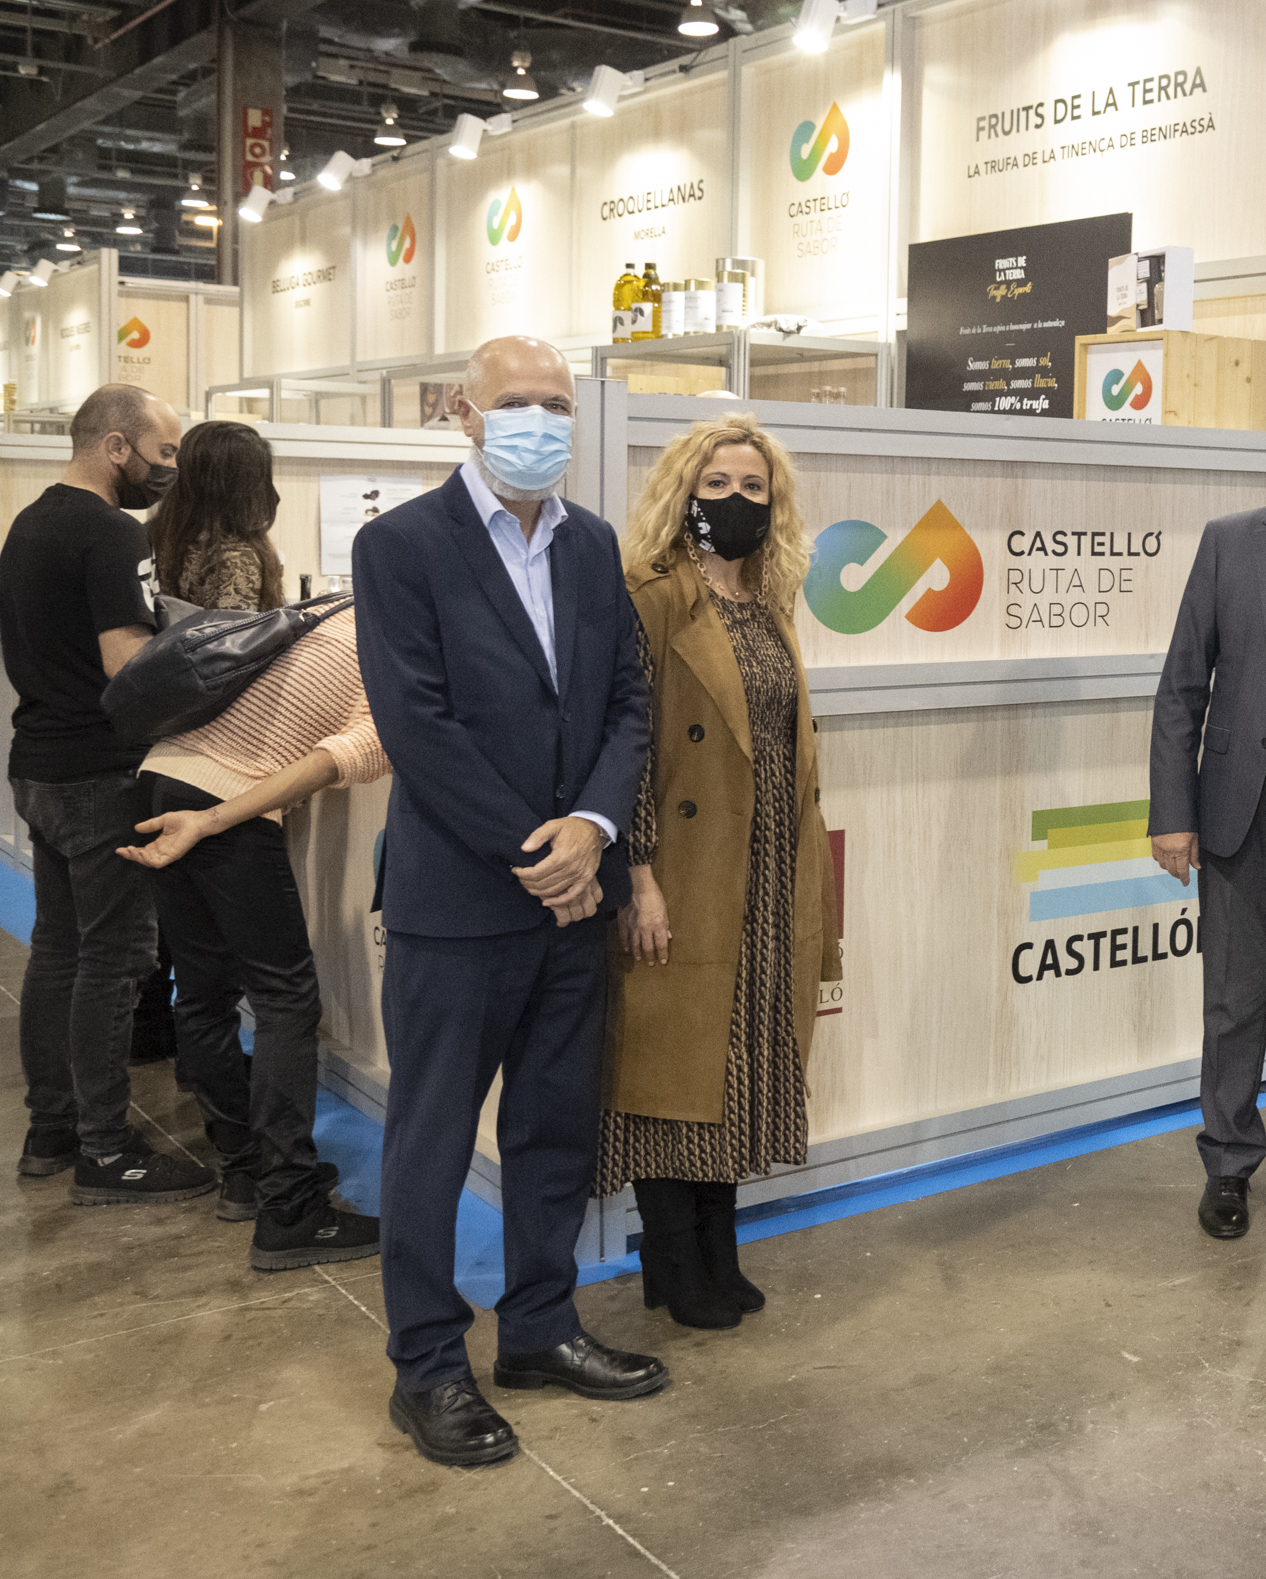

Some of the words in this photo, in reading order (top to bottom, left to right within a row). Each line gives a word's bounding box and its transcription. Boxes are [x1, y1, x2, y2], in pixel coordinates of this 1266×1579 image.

[975, 102, 1045, 142] FRUITS
[1053, 93, 1082, 125] DE
[1091, 86, 1119, 117] LA
[1127, 66, 1208, 108] TERRA
[967, 163, 981, 179] LA
[984, 156, 1019, 175] TRUFA
[1022, 151, 1038, 168] DE
[1042, 148, 1056, 164] LA
[1060, 137, 1115, 160] TINENÇA
[1119, 131, 1137, 149] DE
[1141, 112, 1216, 145] BENIFASSÀ
[600, 179, 705, 222] CROQUELLANAS
[633, 226, 666, 241] MORELLA
[793, 219, 823, 239] RUTA
[827, 215, 843, 233] DE
[797, 236, 838, 259] SABOR
[995, 257, 1017, 270] FRUITS
[1017, 255, 1027, 267] DE
[302, 265, 337, 288] GOURMET
[996, 271, 1005, 281] LA
[1005, 268, 1026, 280] TERRA
[966, 356, 990, 371] Somos
[990, 355, 1013, 371] tierra,
[1014, 357, 1038, 368] somos
[1038, 351, 1052, 369] sol,
[962, 380, 984, 391] somos
[984, 376, 1008, 392] viento,
[1009, 378, 1033, 389] somos
[1033, 373, 1058, 390] lluvia,
[970, 401, 993, 412] somos
[993, 396, 1021, 411] 100%
[1022, 394, 1050, 413] trufa
[1006, 529, 1163, 558] CASTELLÓ
[1006, 567, 1086, 595] RUTA
[1097, 567, 1134, 594] DE
[1005, 601, 1111, 630] SABOR
[1012, 906, 1203, 985] CASTELLÓ
